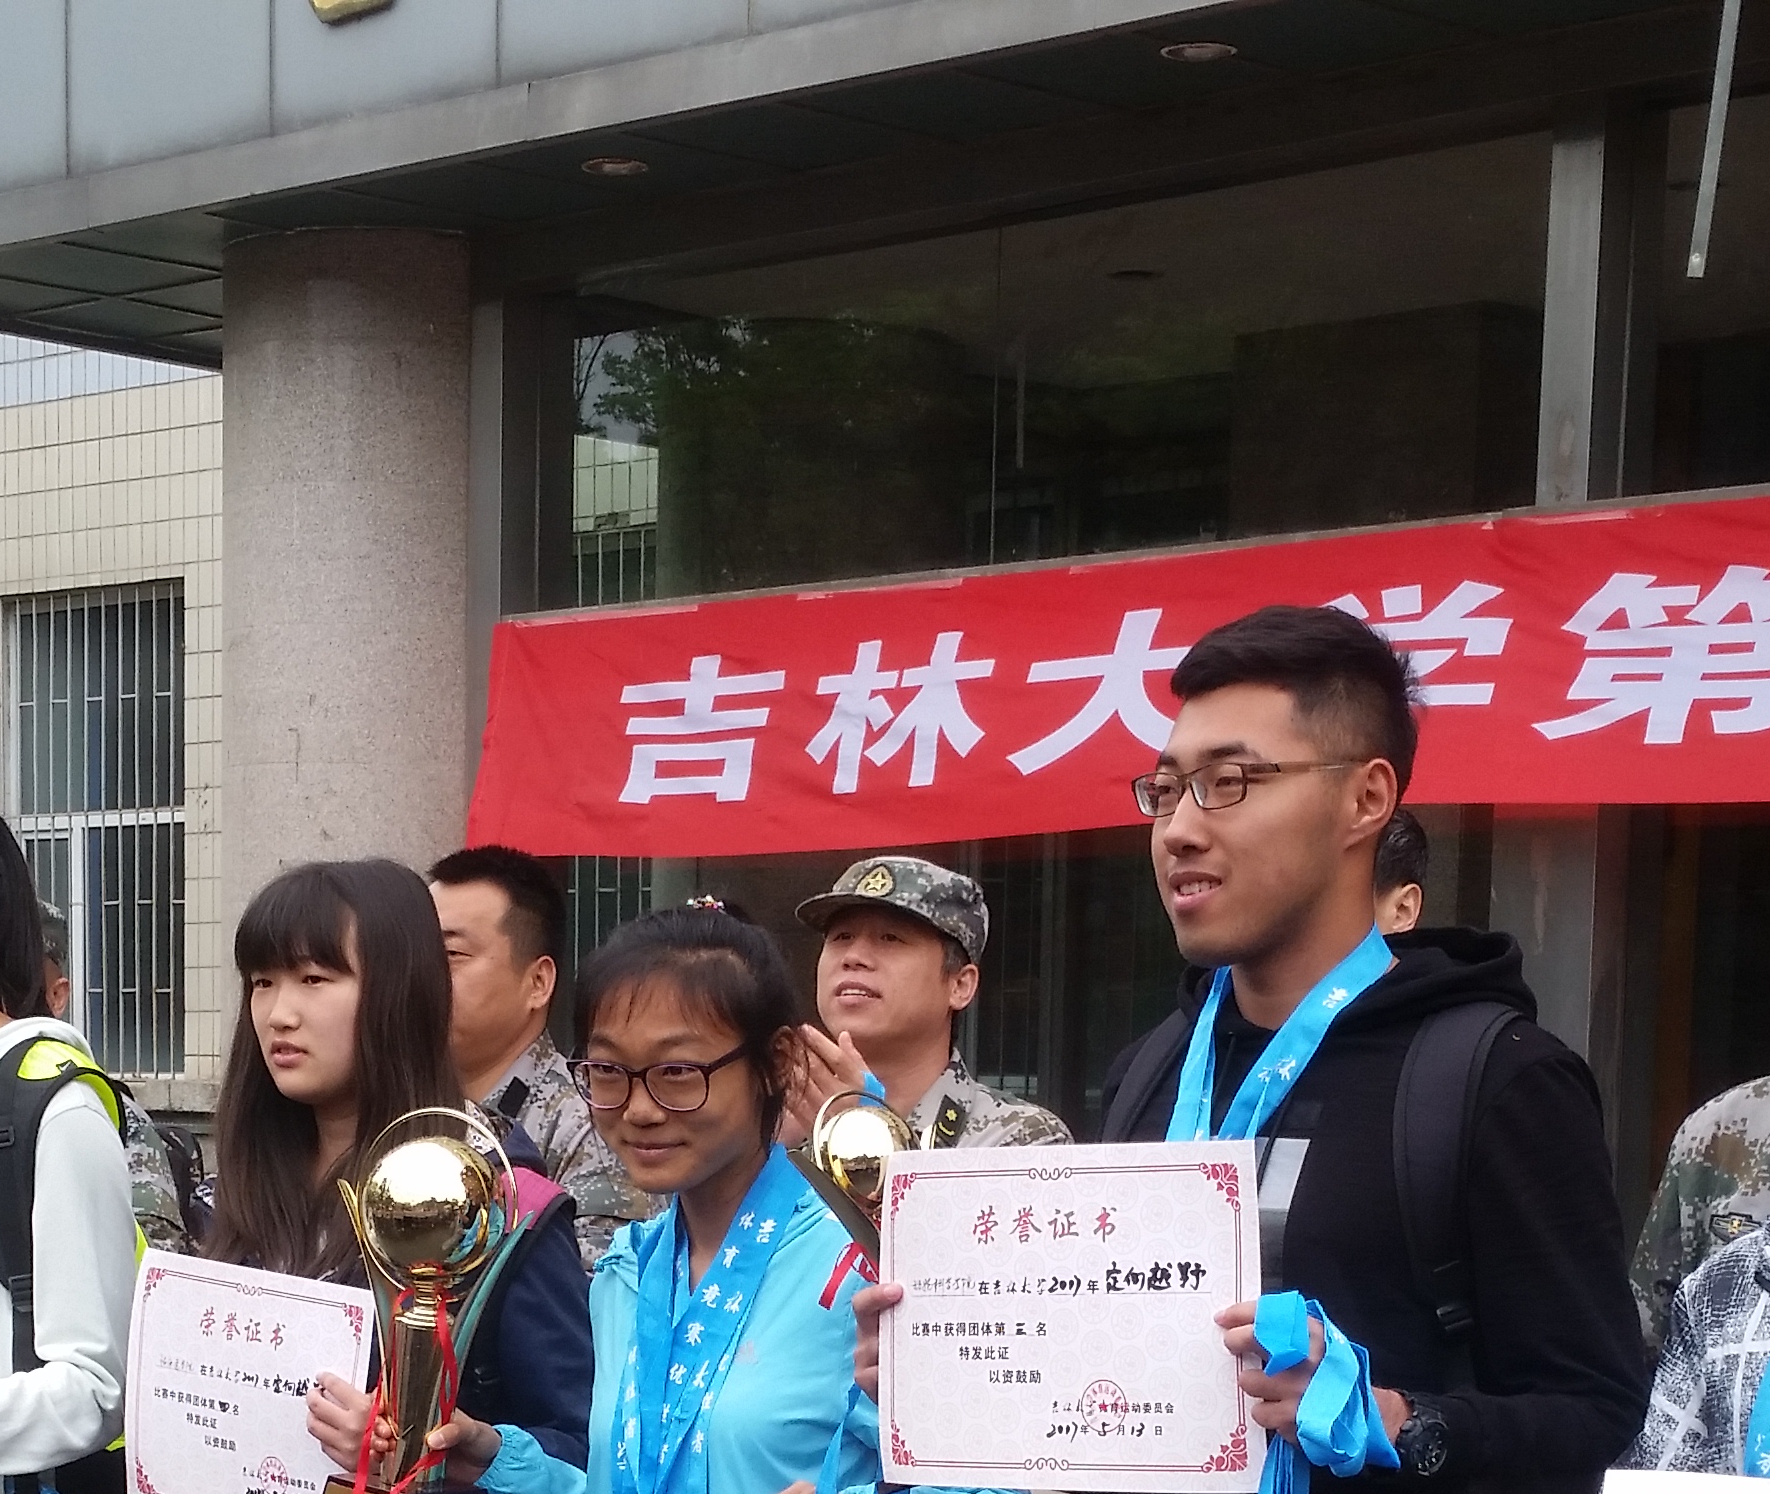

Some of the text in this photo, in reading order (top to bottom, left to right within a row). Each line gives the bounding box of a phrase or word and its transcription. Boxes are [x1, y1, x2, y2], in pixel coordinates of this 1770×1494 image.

[972, 1205, 1119, 1245] 荣誉证书
[199, 1306, 287, 1351] 荣誉证书
[911, 1322, 1048, 1337] 比赛中获得团体第三名
[959, 1346, 1010, 1361] 特发此证
[989, 1370, 1042, 1385] 以资鼓励
